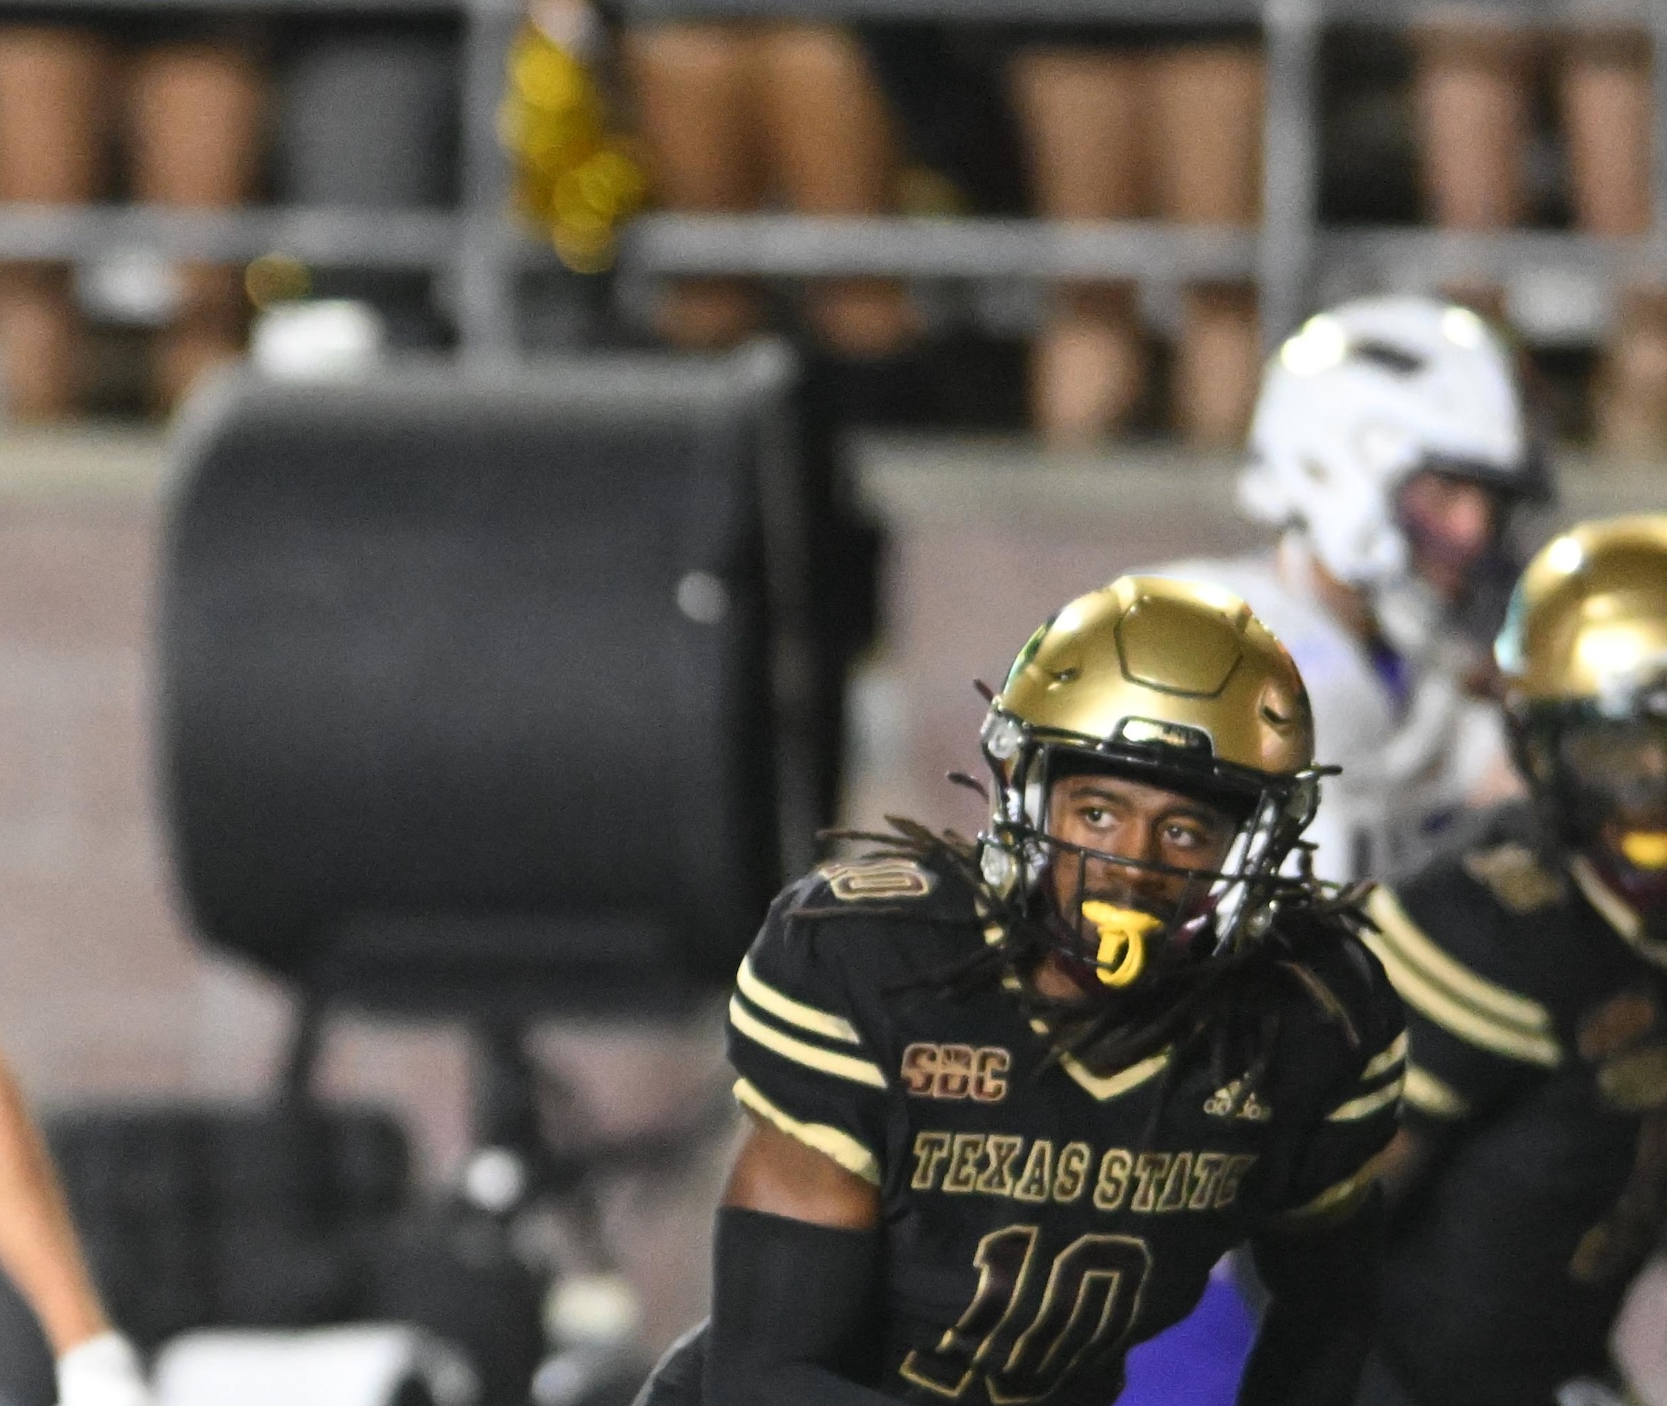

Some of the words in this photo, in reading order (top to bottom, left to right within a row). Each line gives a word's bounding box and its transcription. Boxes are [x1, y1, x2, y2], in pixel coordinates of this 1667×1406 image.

[900, 1041, 1011, 1102] SBC
[911, 1131, 1091, 1203] TEXAS
[1092, 1147, 1259, 1213] STATE
